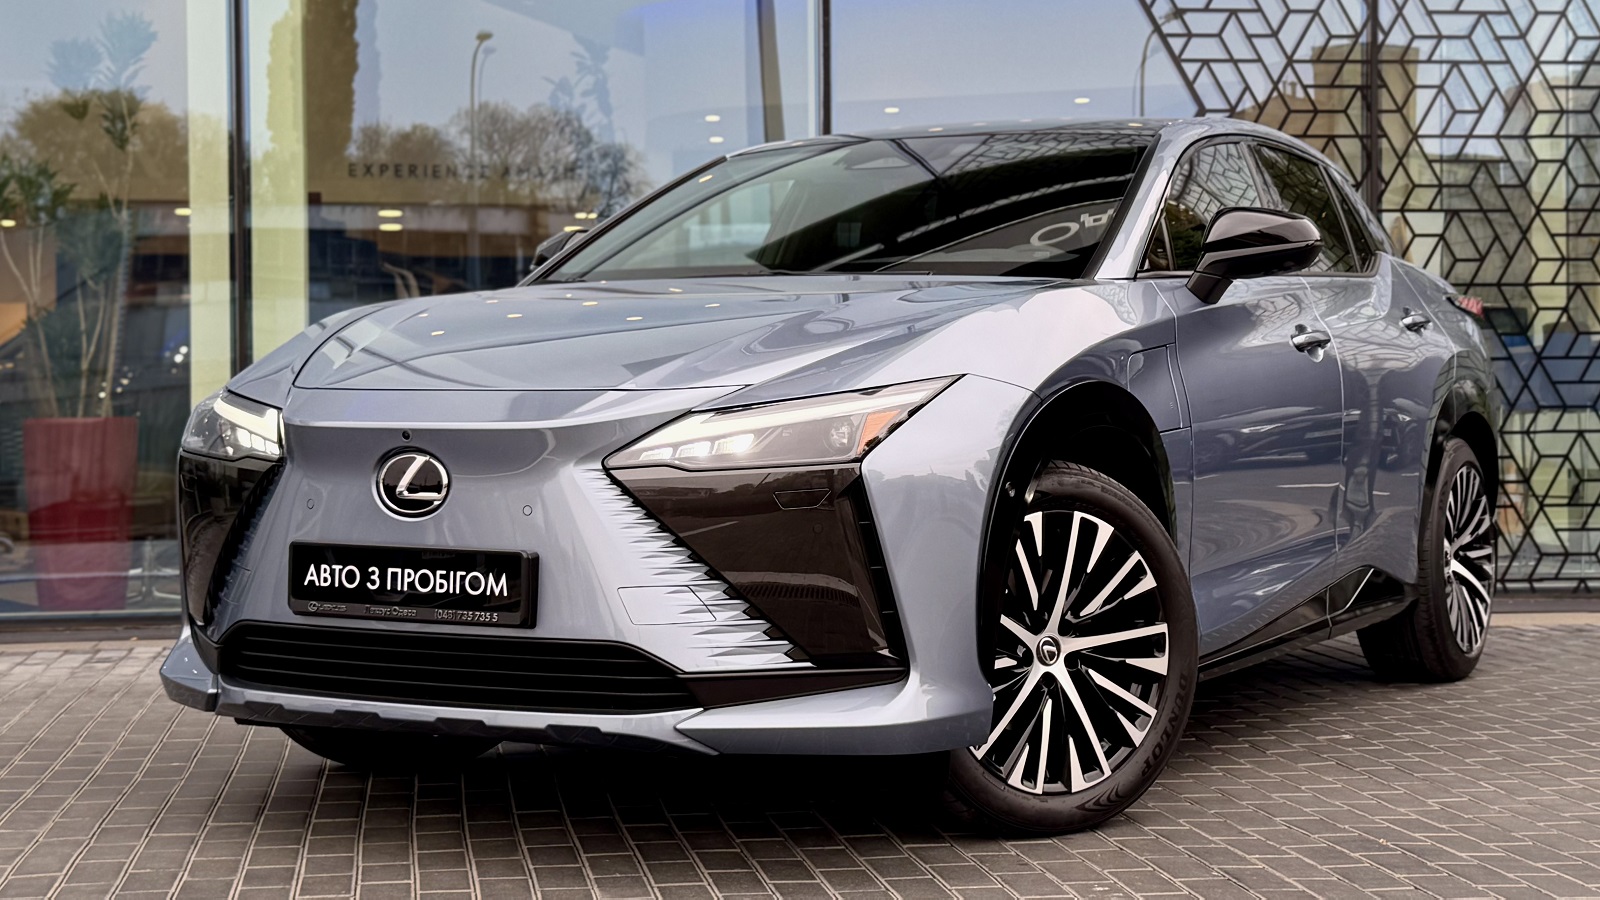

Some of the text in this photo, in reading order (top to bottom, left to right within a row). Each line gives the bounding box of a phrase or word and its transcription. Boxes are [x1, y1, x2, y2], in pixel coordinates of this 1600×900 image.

[347, 163, 489, 179] EXPERIENCE
[304, 563, 361, 588] АВТО
[387, 567, 508, 596] ПРОБІГОМ
[1140, 672, 1188, 777] DUNLOP
